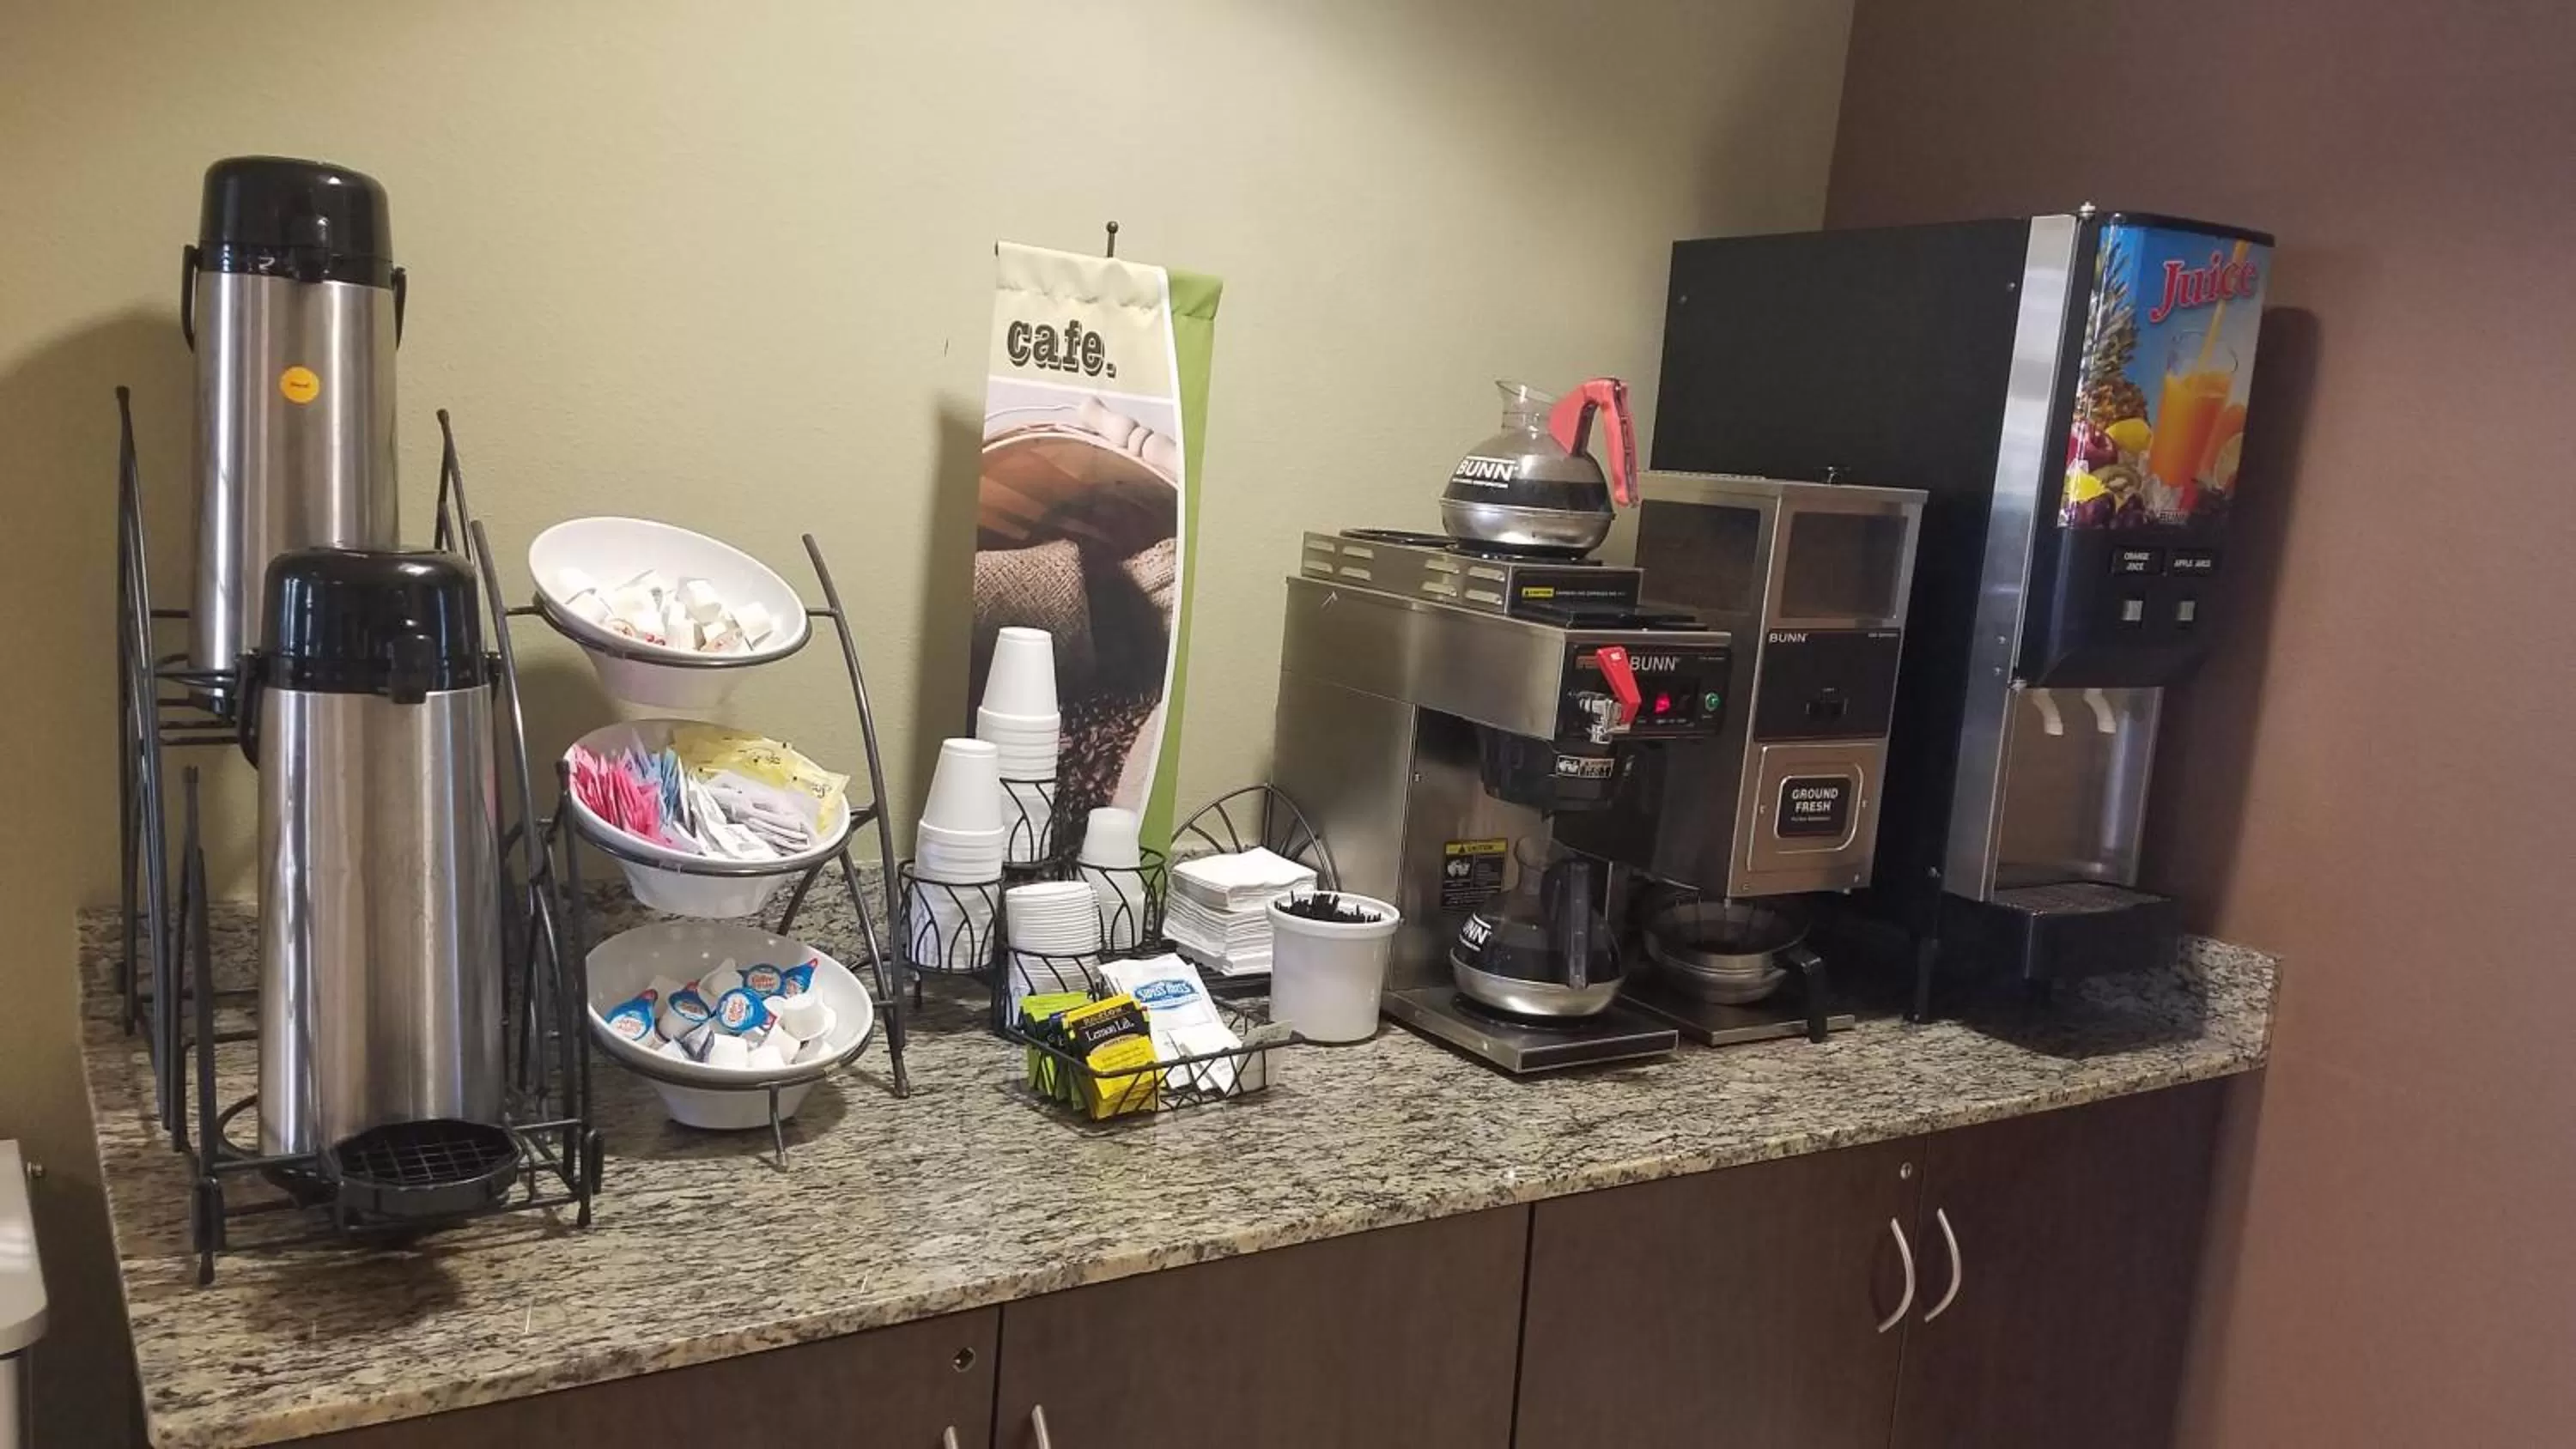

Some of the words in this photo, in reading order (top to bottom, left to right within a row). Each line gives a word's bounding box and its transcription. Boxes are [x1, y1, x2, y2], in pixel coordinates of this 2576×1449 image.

[2149, 252, 2257, 323] Juice
[1006, 318, 1117, 379] cafe.
[1456, 459, 1514, 482] BUNN
[1769, 633, 1807, 643] BUNN
[1630, 655, 1677, 671] BUNN
[1792, 787, 1838, 799] GROUND
[1795, 801, 1832, 812] FRESH
[1085, 1024, 1117, 1041] Lemon
